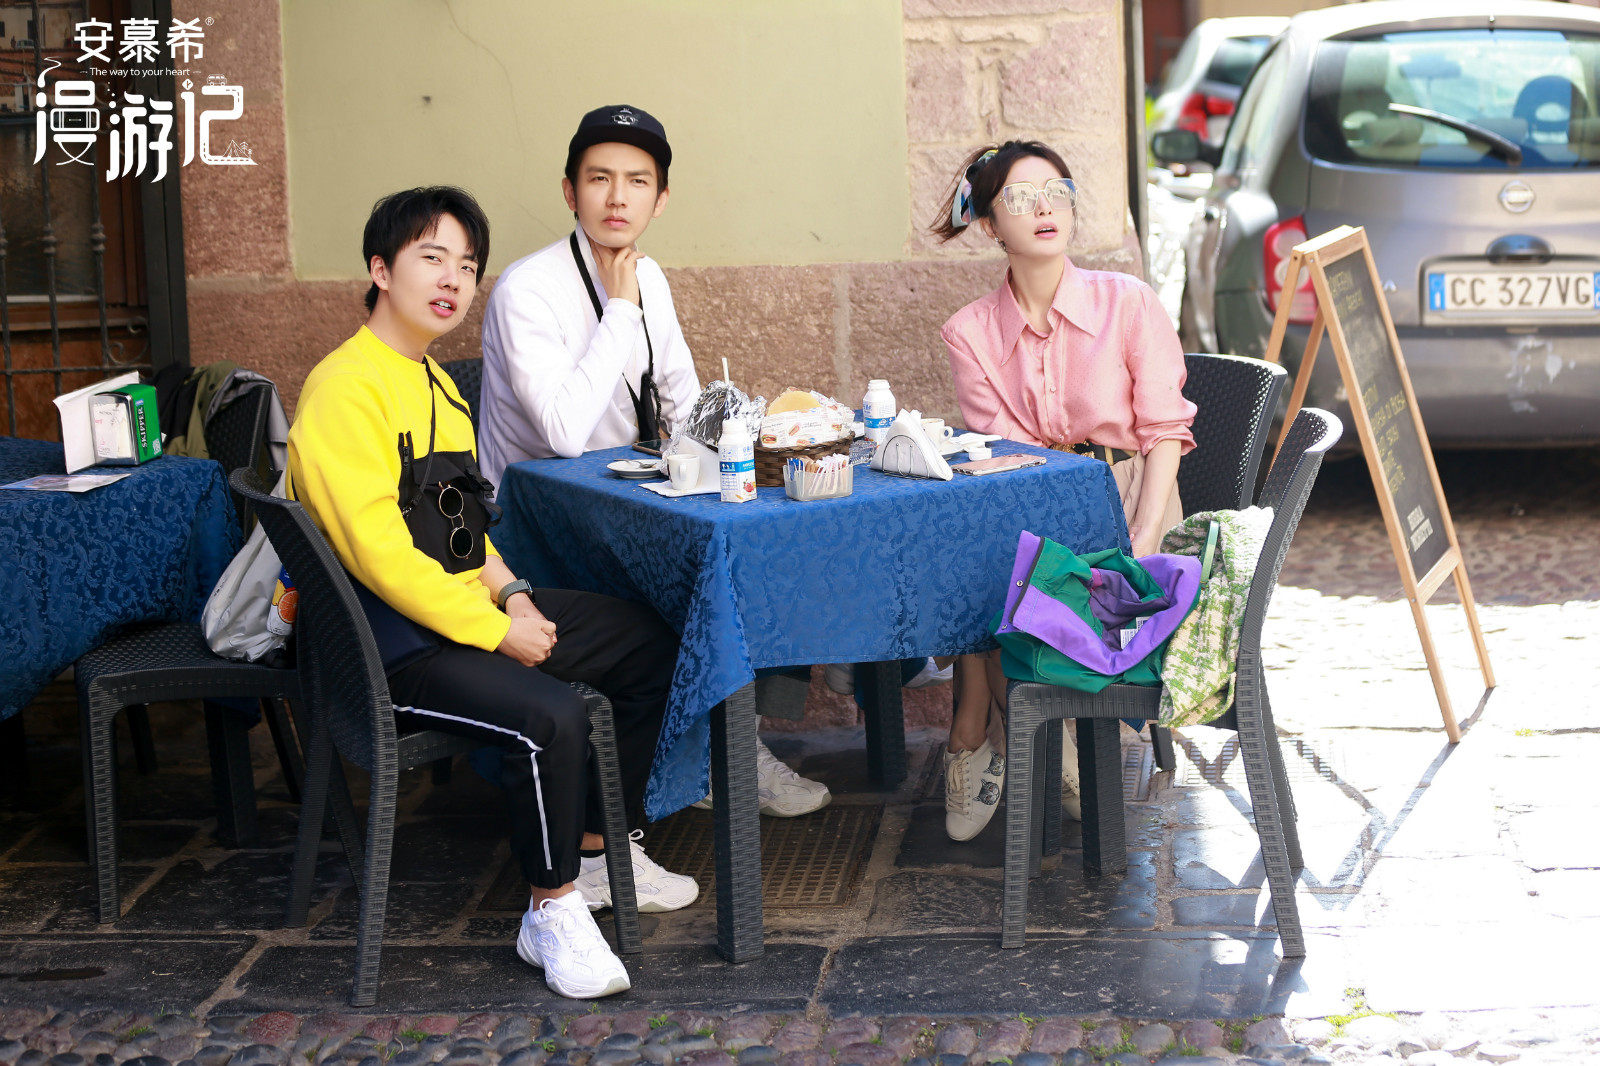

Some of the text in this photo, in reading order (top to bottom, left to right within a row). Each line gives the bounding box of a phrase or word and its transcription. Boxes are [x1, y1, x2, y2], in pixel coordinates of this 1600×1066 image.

[1450, 277, 1487, 306] CC
[1497, 277, 1591, 306] 327VG
[138, 406, 148, 448] SKIPPER
